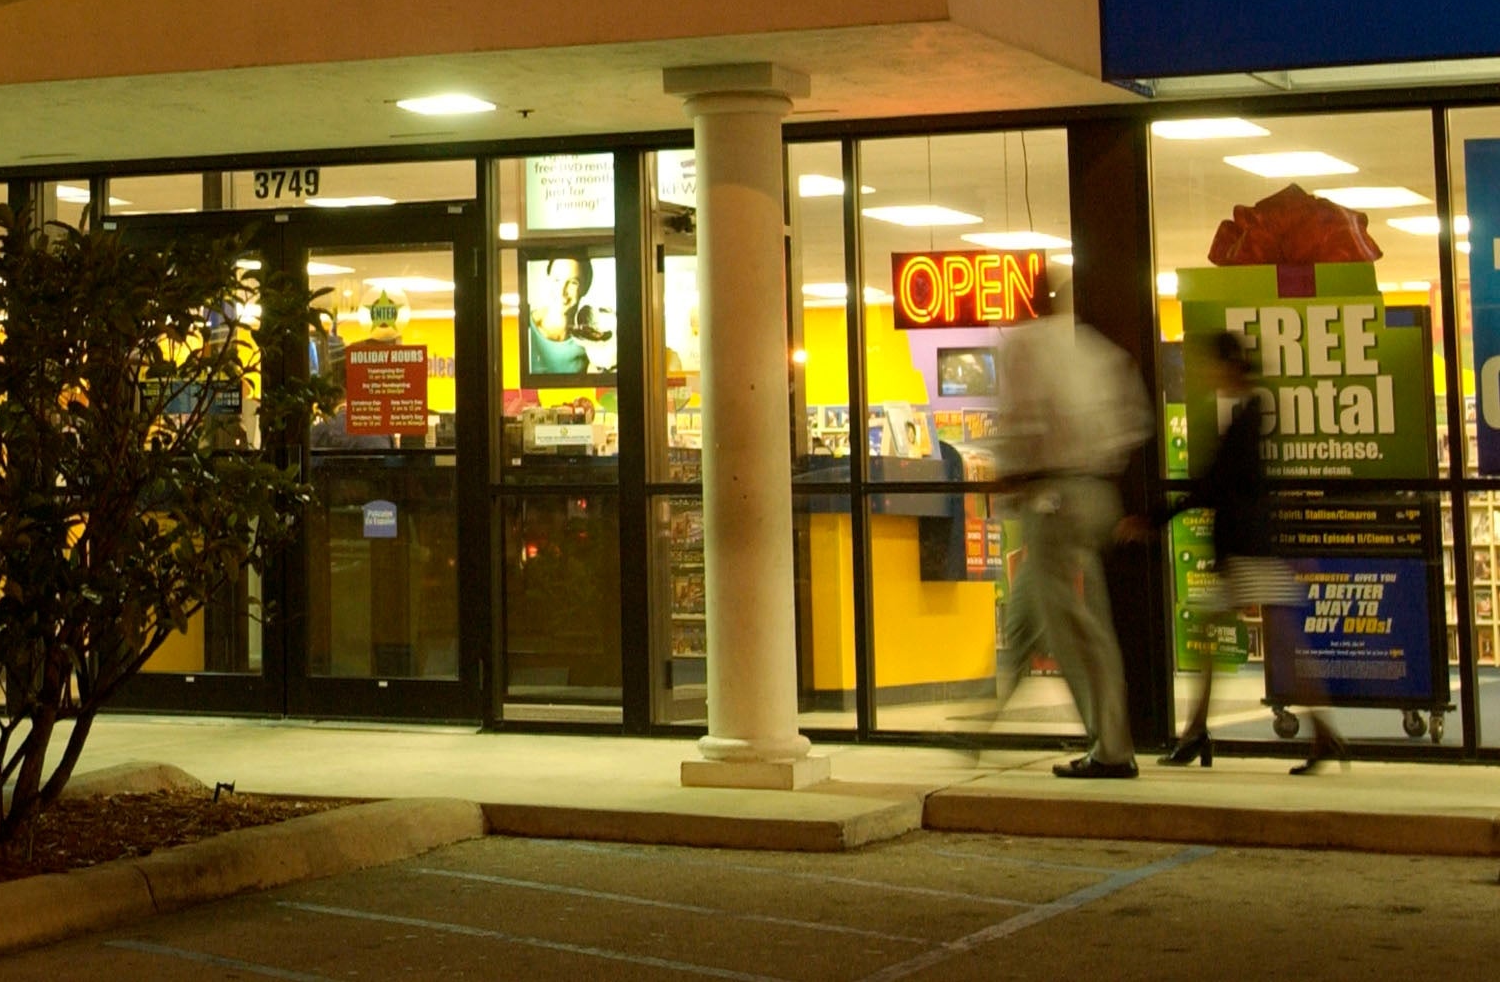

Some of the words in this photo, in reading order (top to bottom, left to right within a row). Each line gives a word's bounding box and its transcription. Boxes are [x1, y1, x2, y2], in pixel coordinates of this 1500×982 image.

[255, 169, 319, 199] 3749
[901, 253, 1039, 323] OPEN
[371, 306, 397, 321] ENTER
[1225, 304, 1380, 377] FREE
[350, 350, 389, 364] HOLIDAY
[390, 349, 424, 363] HOURS
[1283, 438, 1384, 462] purchase.
[1354, 573, 1378, 583] GIVES
[1380, 573, 1397, 582] YOU
[1307, 583, 1320, 600] A
[1325, 583, 1384, 600] BETTER
[1315, 600, 1353, 617] WAY
[1357, 600, 1380, 616] TO
[1304, 617, 1339, 634] BUY
[1343, 617, 1393, 634] DVDs!
